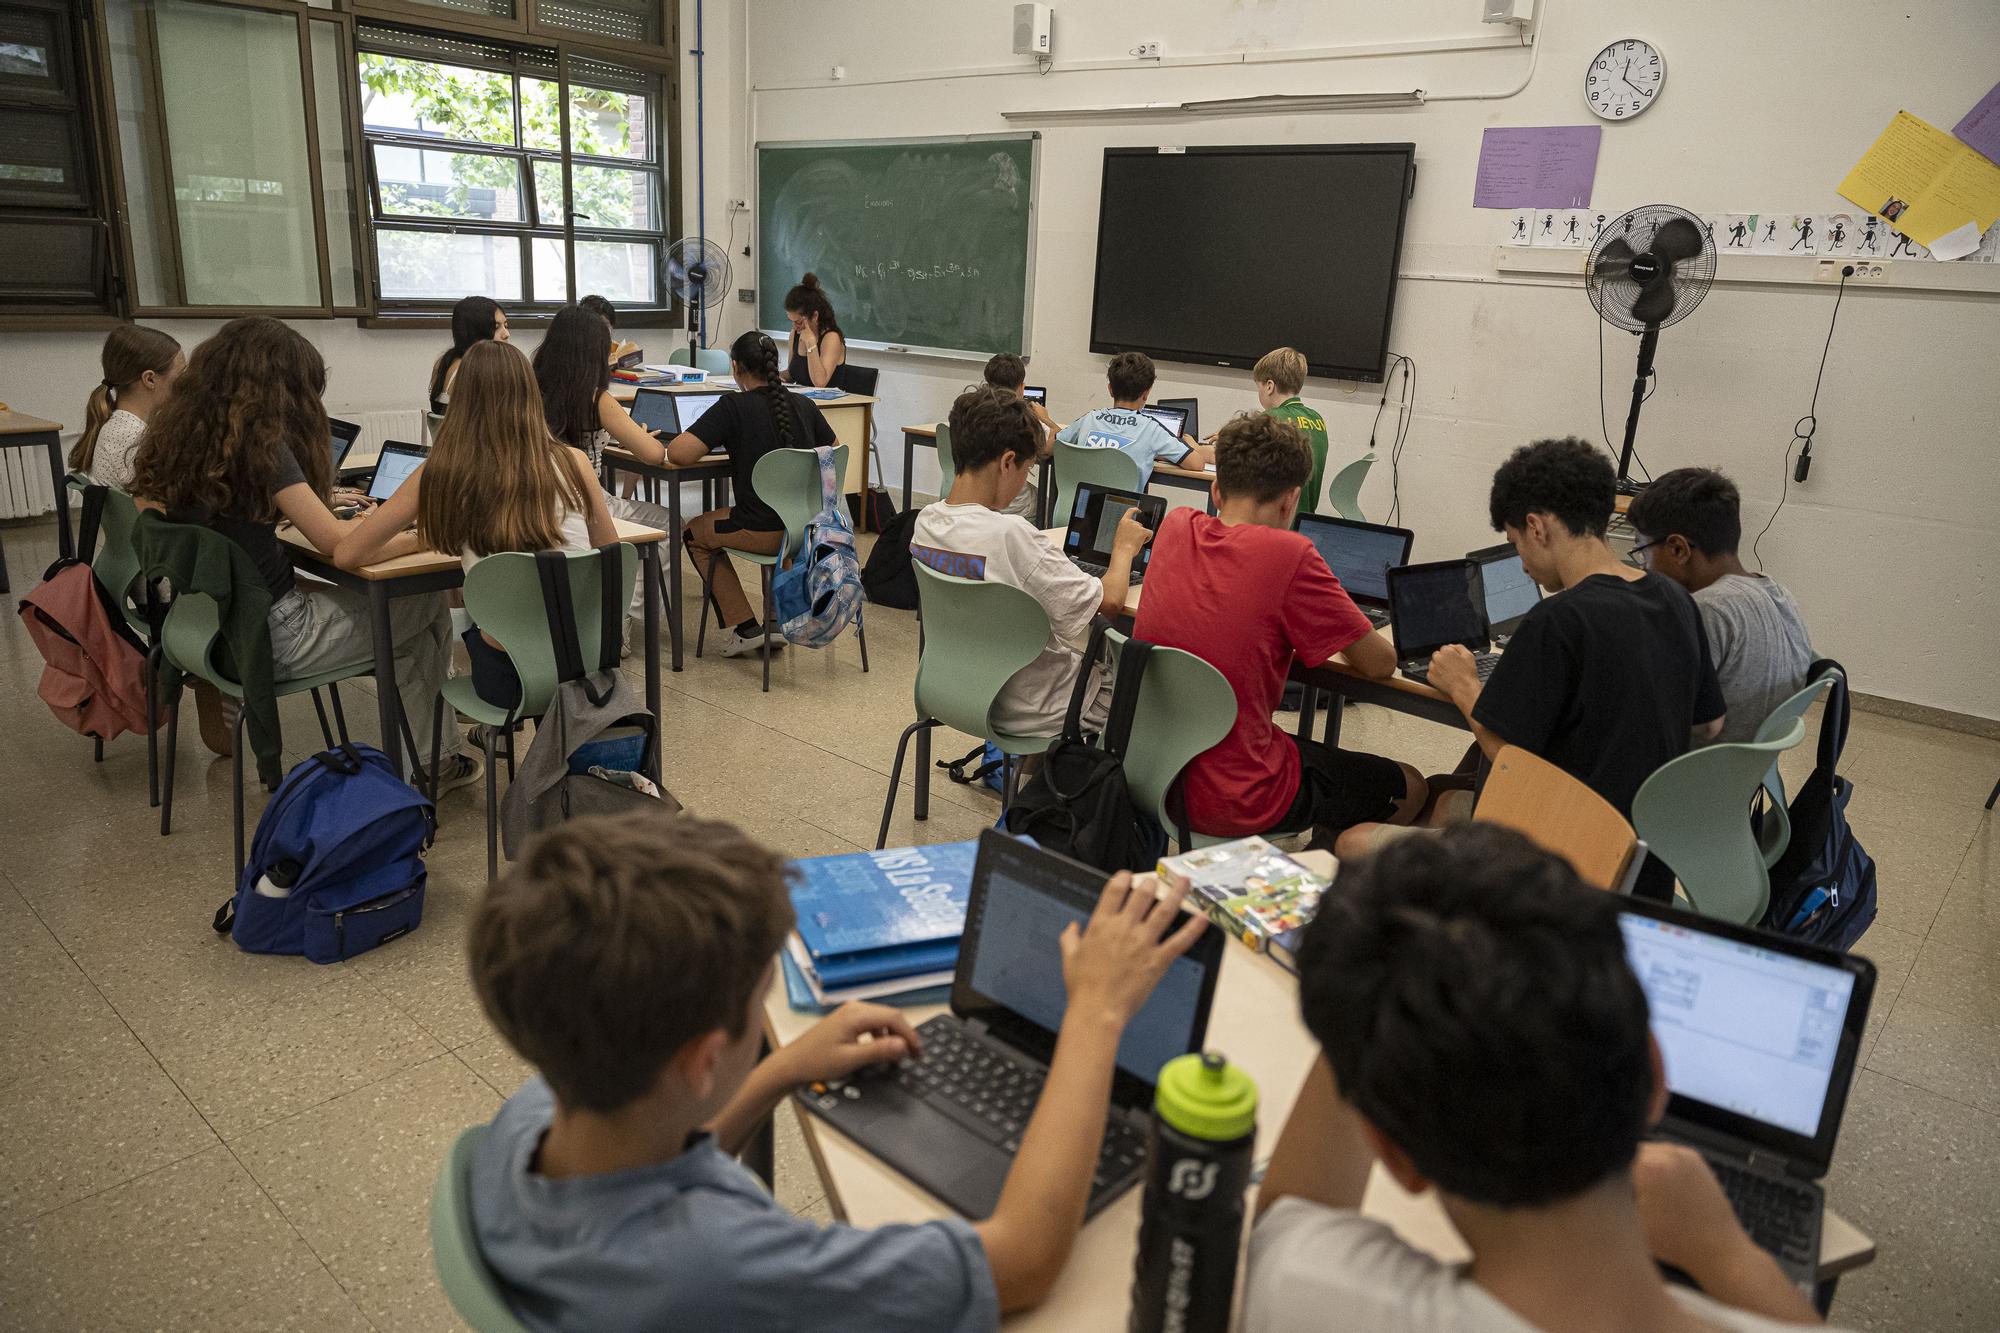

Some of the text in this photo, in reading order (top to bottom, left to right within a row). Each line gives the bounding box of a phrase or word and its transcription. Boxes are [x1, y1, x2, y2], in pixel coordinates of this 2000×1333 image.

[1623, 41, 1635, 51] 12
[1643, 44, 1648, 54] 1
[1607, 48, 1616, 58] 11
[1595, 60, 1607, 70] 10
[1650, 55, 1659, 65] 2
[1589, 76, 1597, 86] 9
[1652, 71, 1661, 81] 3
[1591, 91, 1600, 101] 8
[1644, 88, 1653, 98] 4
[1601, 102, 1609, 112] 7
[1632, 100, 1640, 111] 5
[1615, 106, 1624, 117] 6
